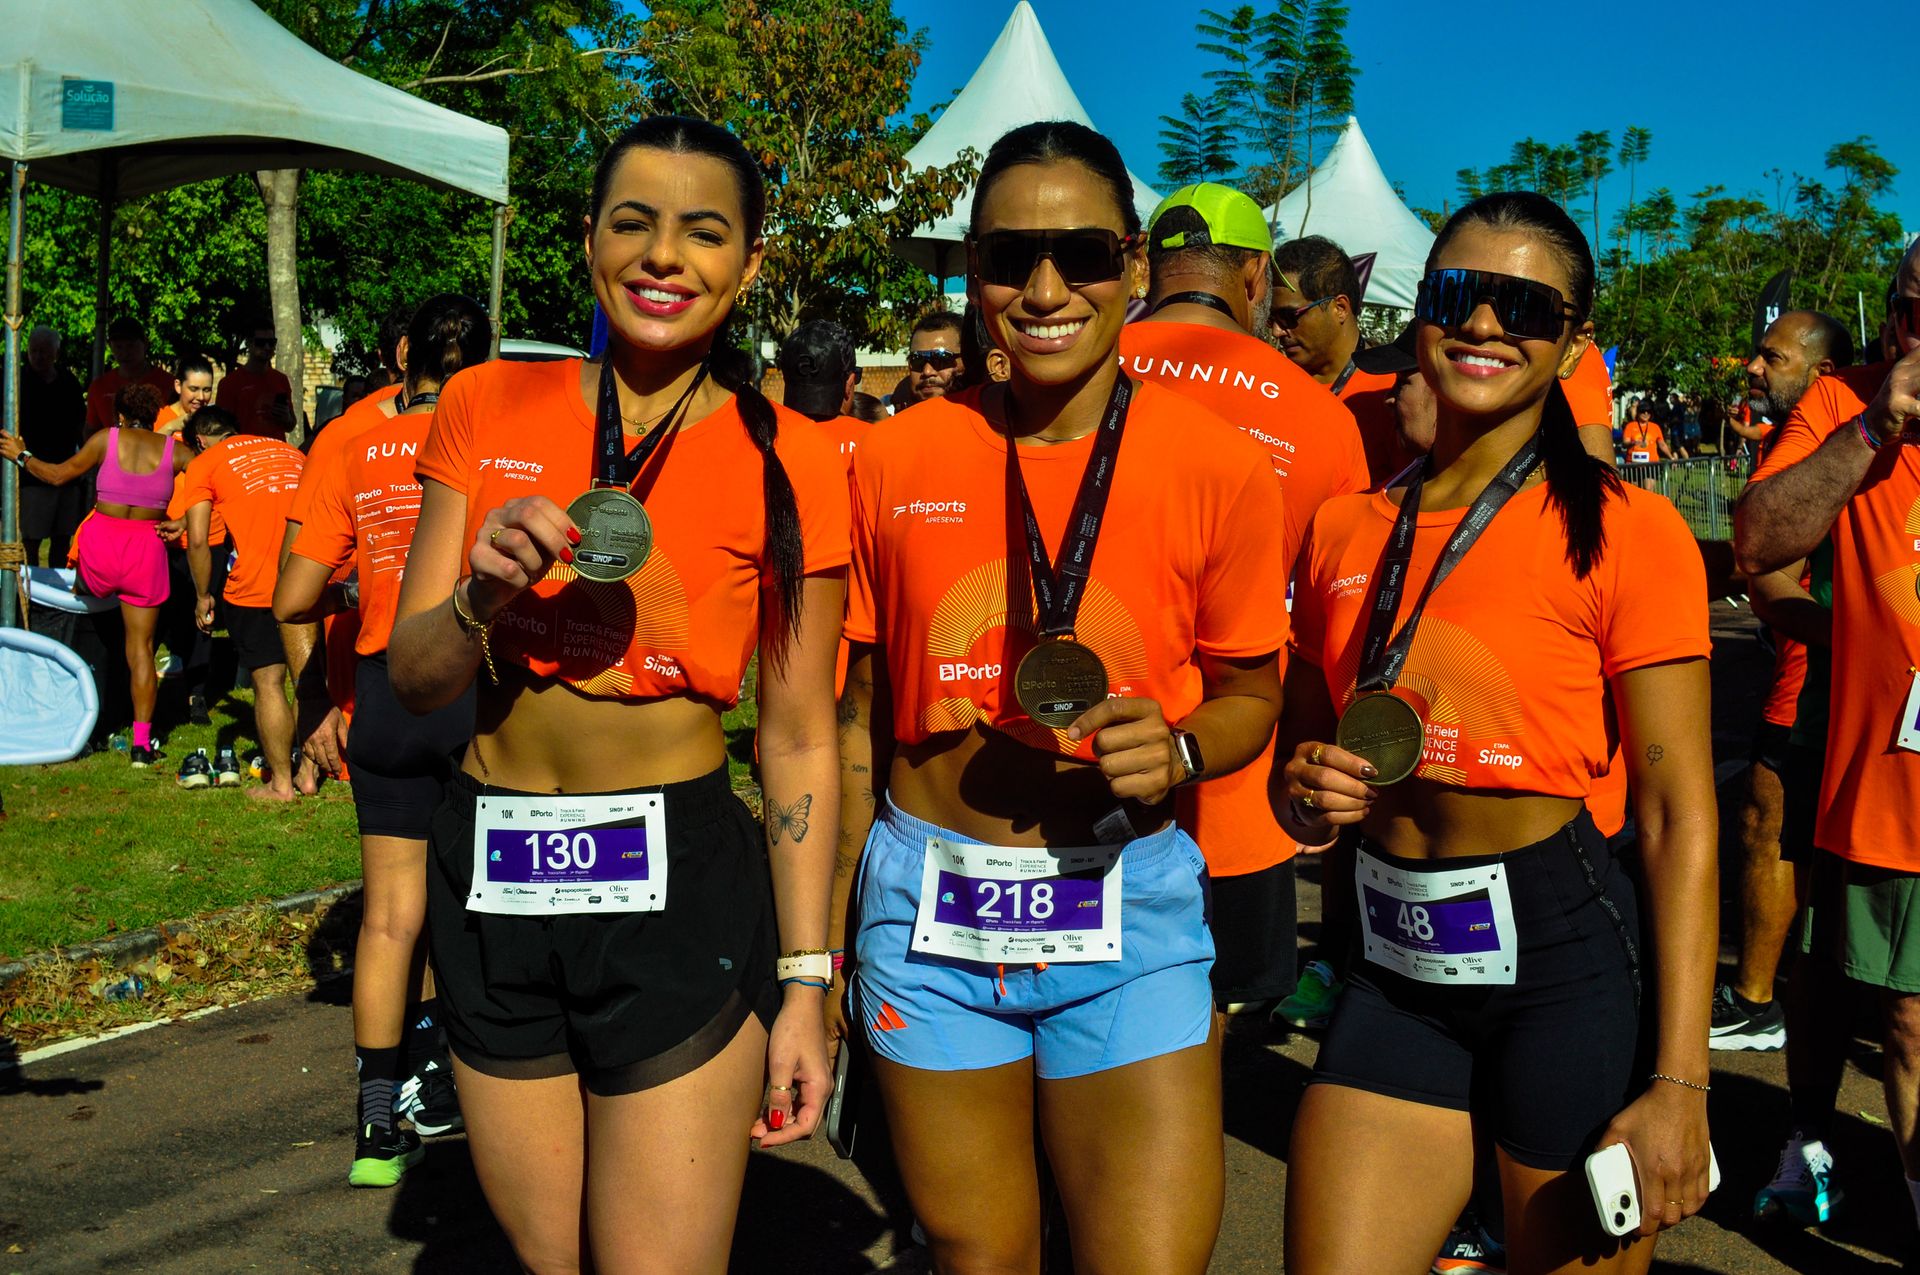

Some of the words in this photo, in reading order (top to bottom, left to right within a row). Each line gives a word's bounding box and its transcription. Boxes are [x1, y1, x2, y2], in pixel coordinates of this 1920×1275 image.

[67, 89, 110, 106] Solução
[1249, 428, 1296, 454] tfsports
[366, 442, 417, 462] RUN
[495, 456, 544, 474] tfsports
[504, 472, 537, 482] APRESENTA
[359, 488, 382, 501] Porto
[909, 499, 967, 515] tfsports
[925, 516, 964, 524] APRESENTA
[592, 553, 613, 564] SINOP
[508, 611, 548, 635] Porto
[956, 664, 1002, 680] Porto
[1053, 702, 1074, 712] SINOP
[1478, 748, 1523, 770] Sinop
[501, 809, 514, 820] 10K
[536, 809, 553, 817] Porto
[525, 832, 597, 870] 130
[952, 854, 965, 866] 10K
[992, 859, 1013, 867] Porto
[609, 884, 629, 893] Olive
[976, 881, 1055, 919] 218
[1397, 902, 1434, 941] 48
[1062, 933, 1083, 942] Olive
[1462, 955, 1483, 964] Olive
